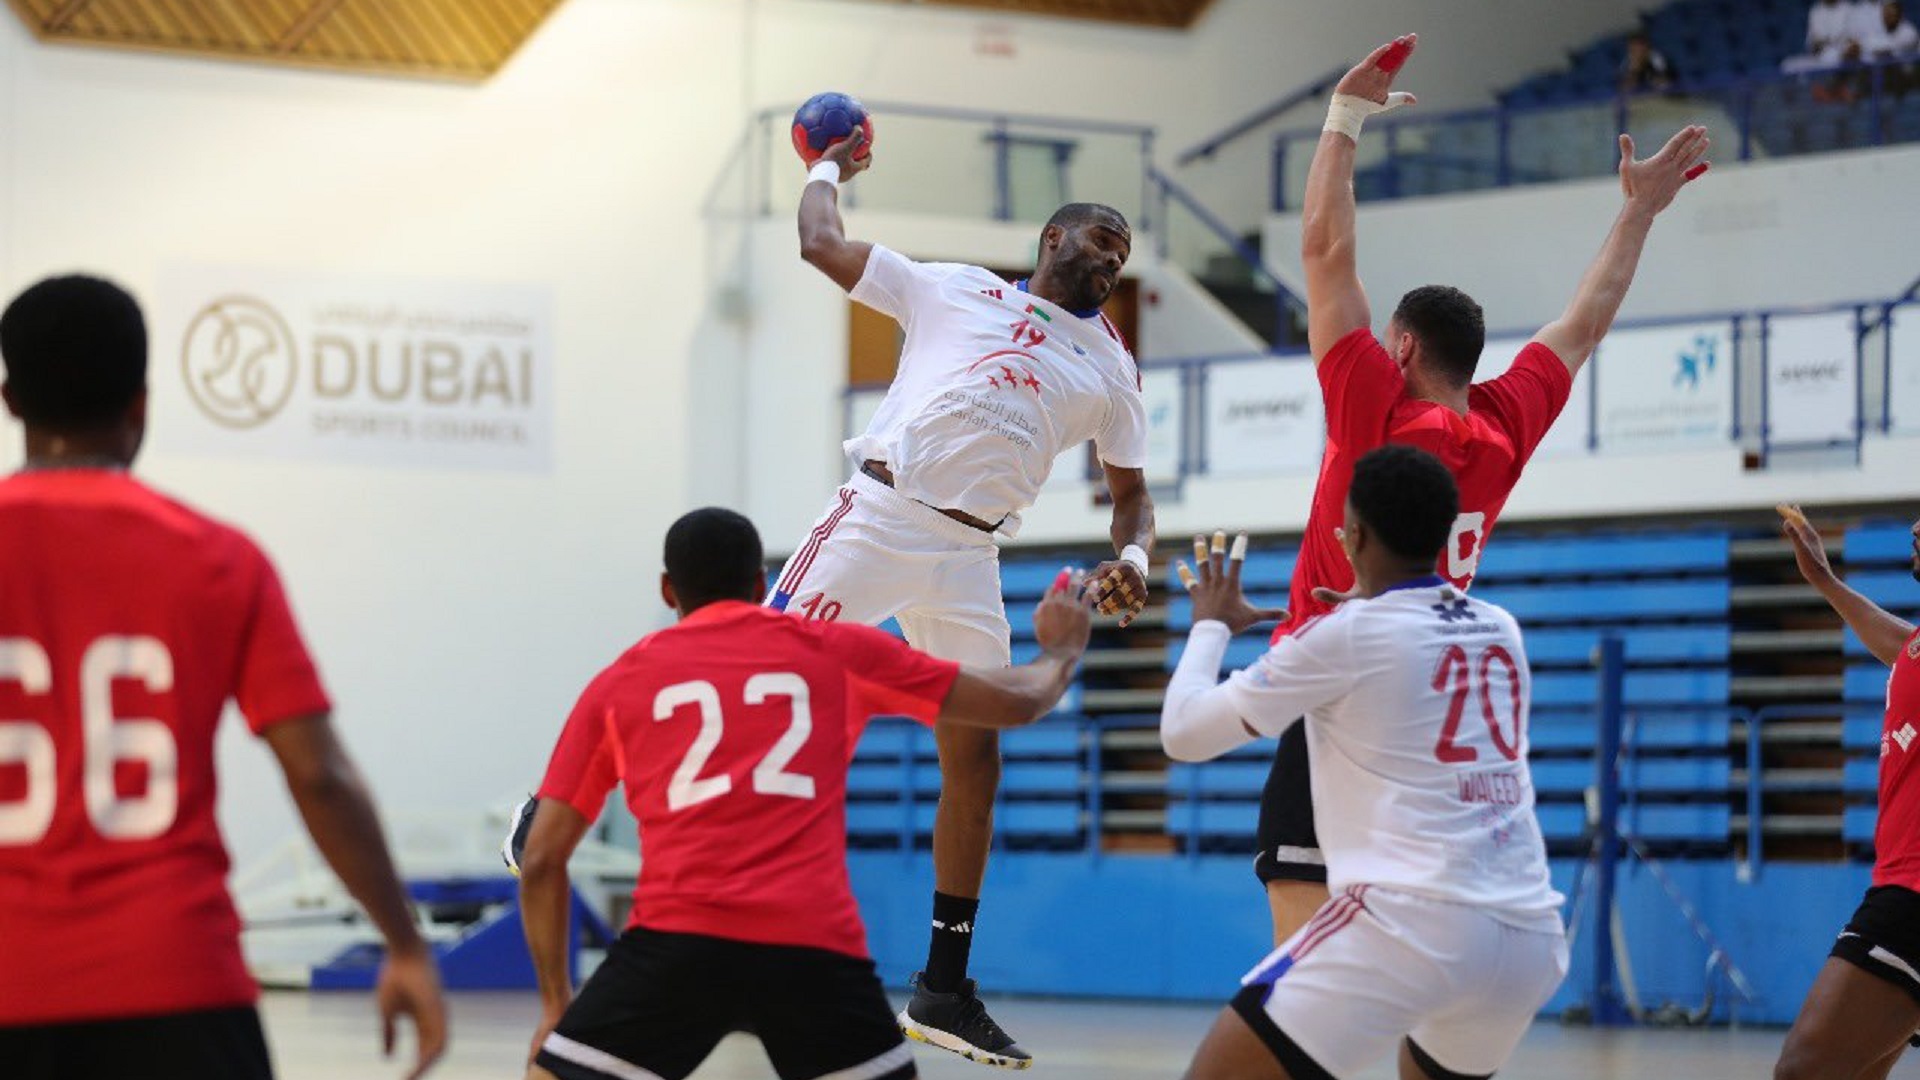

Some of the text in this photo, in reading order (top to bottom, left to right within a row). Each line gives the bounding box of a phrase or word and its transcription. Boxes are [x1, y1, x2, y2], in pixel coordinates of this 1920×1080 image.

[1009, 320, 1047, 348] 19
[312, 335, 533, 408] DUBAI
[990, 423, 1033, 450] Airport
[1432, 644, 1521, 762] 20
[0, 635, 178, 845] 66
[653, 671, 816, 812] 22
[1457, 773, 1521, 805] WALEED
